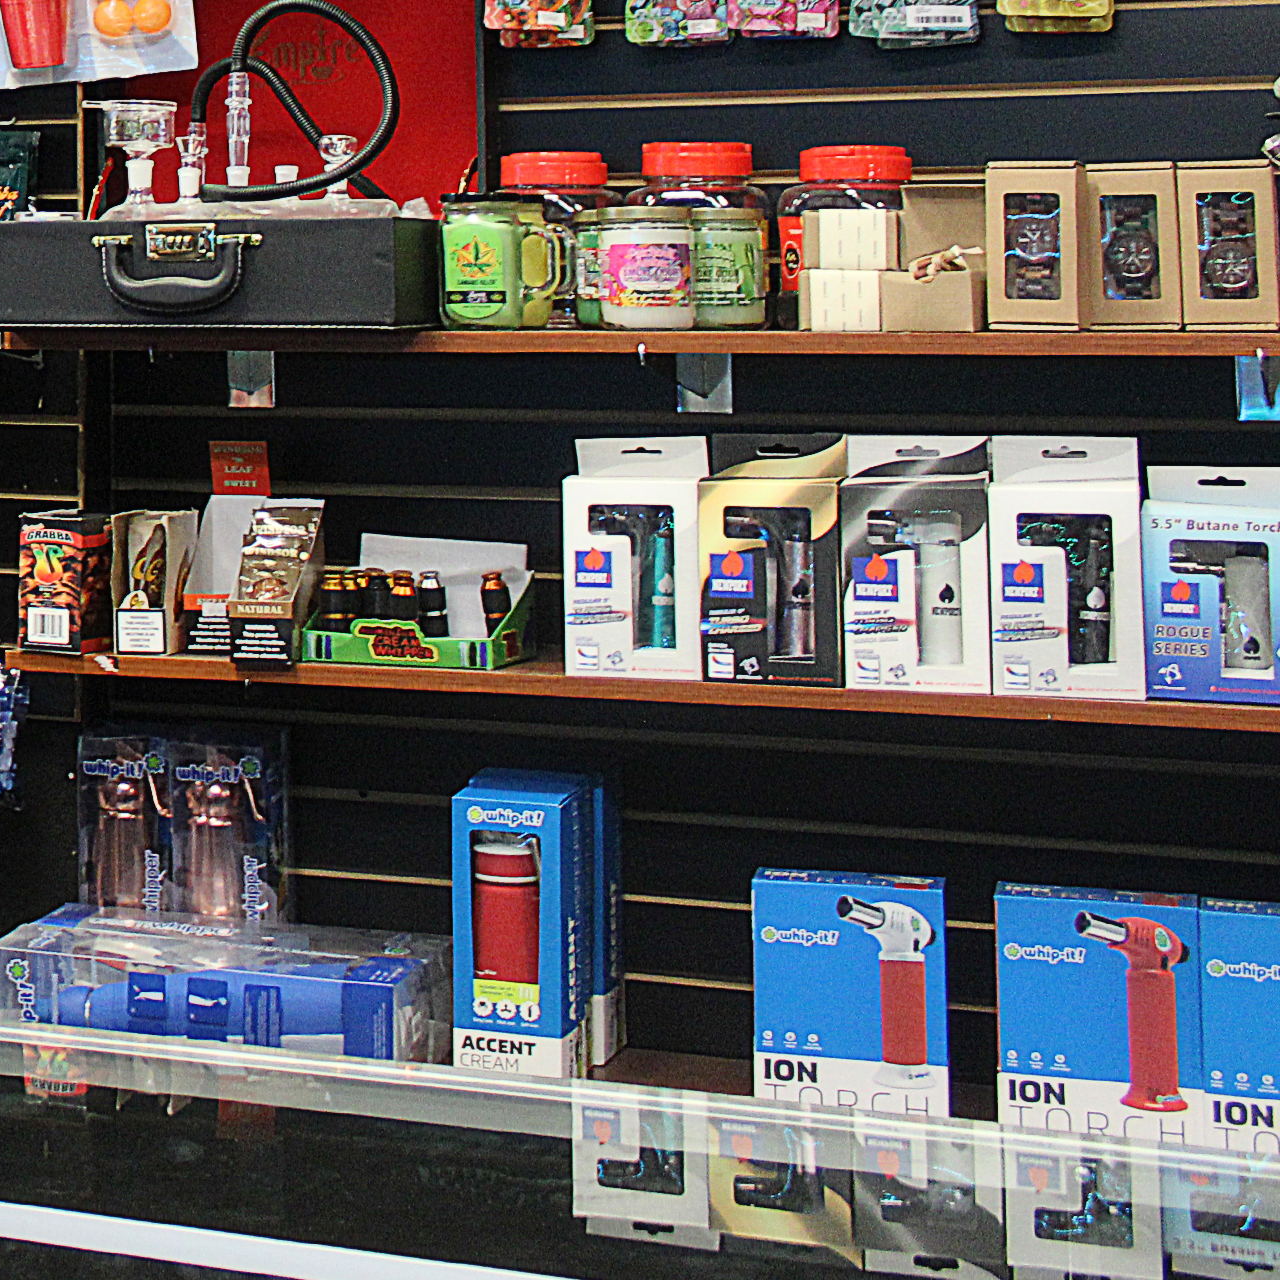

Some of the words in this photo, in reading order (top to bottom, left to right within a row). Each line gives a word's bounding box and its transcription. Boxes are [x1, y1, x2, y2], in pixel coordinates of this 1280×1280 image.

[224, 465, 253, 474] LEAF
[223, 479, 258, 488] SWEET
[1186, 519, 1239, 532] Butane
[26, 530, 73, 543] GRABBA
[242, 547, 298, 559] WINDSOR
[237, 604, 285, 615] NATURAL
[1155, 625, 1211, 639] ROGUE
[376, 636, 420, 647] CREAM
[1154, 642, 1209, 656] SERIES
[375, 646, 434, 659] WHIPPER
[83, 759, 145, 780] whip-it!
[175, 763, 241, 784] whip-it!
[484, 809, 544, 827] whip-it!
[780, 927, 838, 946] whip-it!
[1021, 945, 1086, 964] whip-it!
[461, 1035, 537, 1056] ACCENT
[460, 1053, 520, 1073] CREAM
[763, 1058, 818, 1083] ION
[1008, 1079, 1066, 1106] ION
[1213, 1100, 1274, 1127] ION
